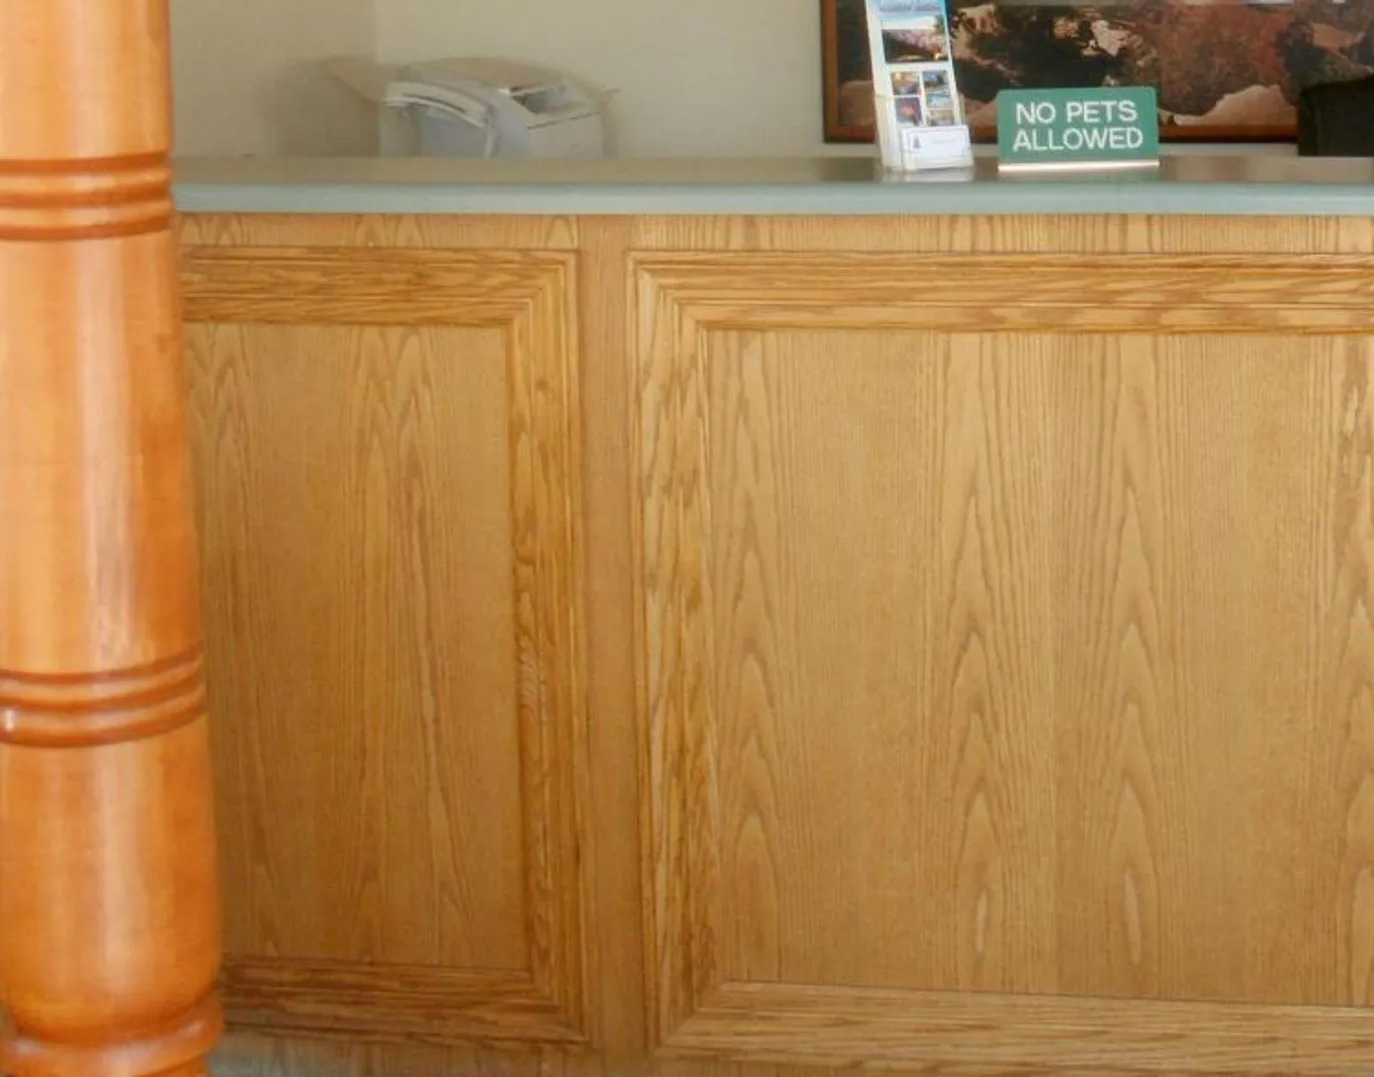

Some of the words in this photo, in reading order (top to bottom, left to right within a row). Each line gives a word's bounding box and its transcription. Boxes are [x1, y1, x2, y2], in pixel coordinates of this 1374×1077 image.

[1015, 102, 1056, 124] NO
[1066, 100, 1138, 123] PETS
[1012, 126, 1144, 152] ALLOWED
